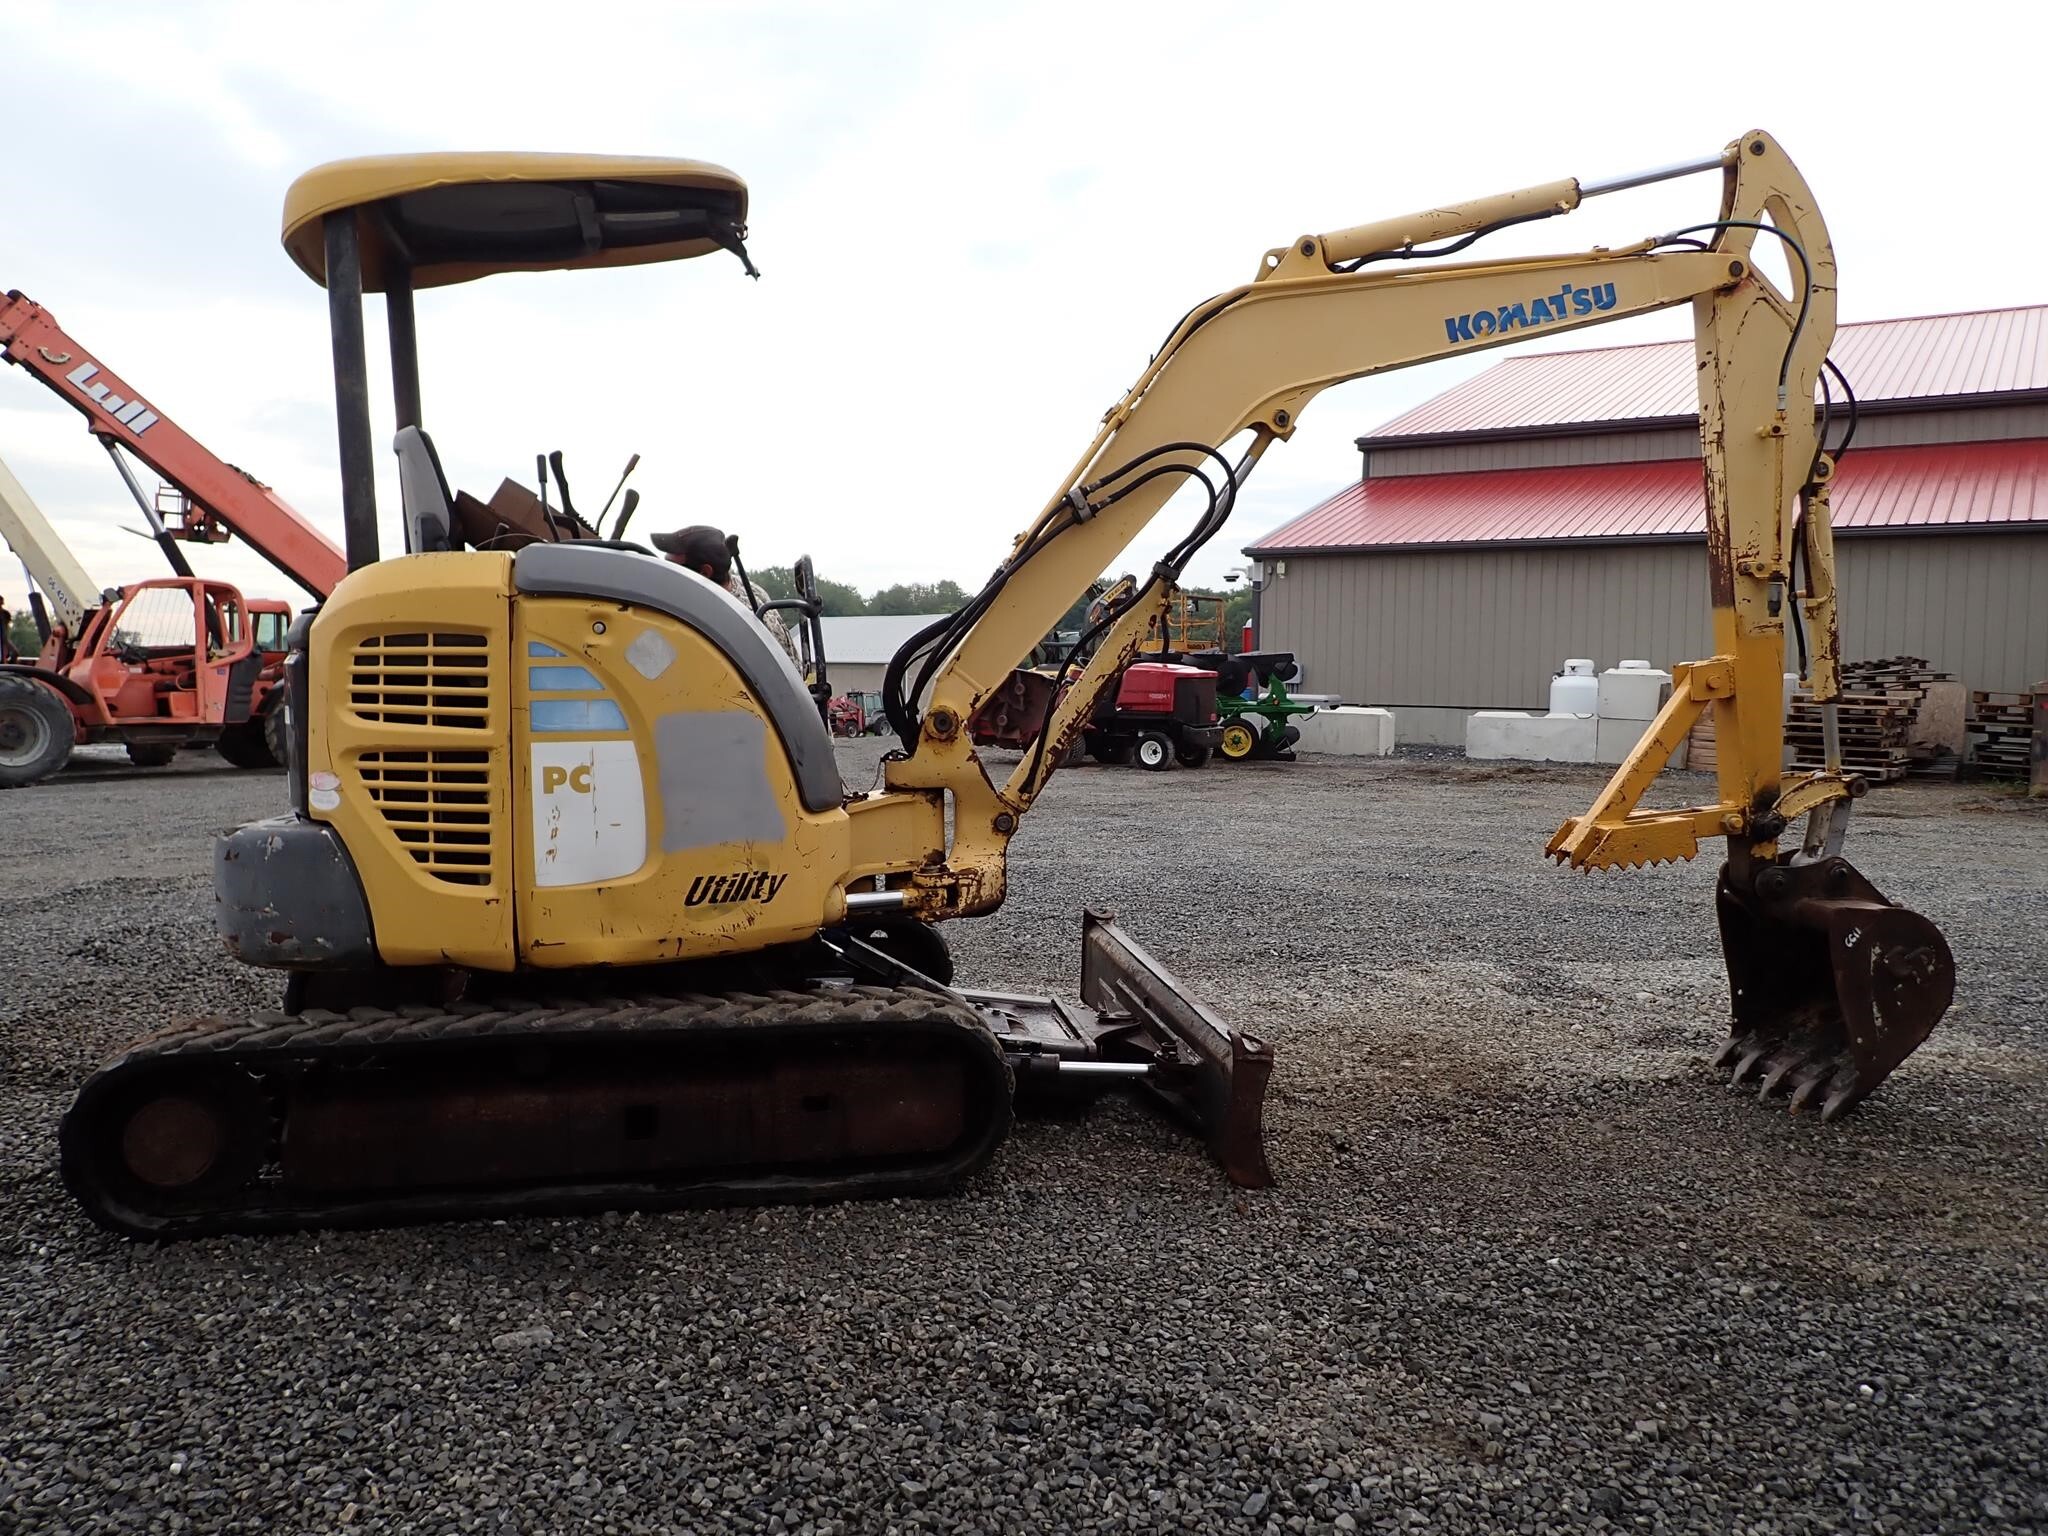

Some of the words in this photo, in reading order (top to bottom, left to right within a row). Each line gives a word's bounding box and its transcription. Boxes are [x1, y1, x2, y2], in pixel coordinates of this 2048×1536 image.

[1444, 283, 1617, 344] KOMATSU
[64, 361, 159, 436] Lull
[543, 765, 591, 794] PC
[684, 871, 788, 906] Utility
